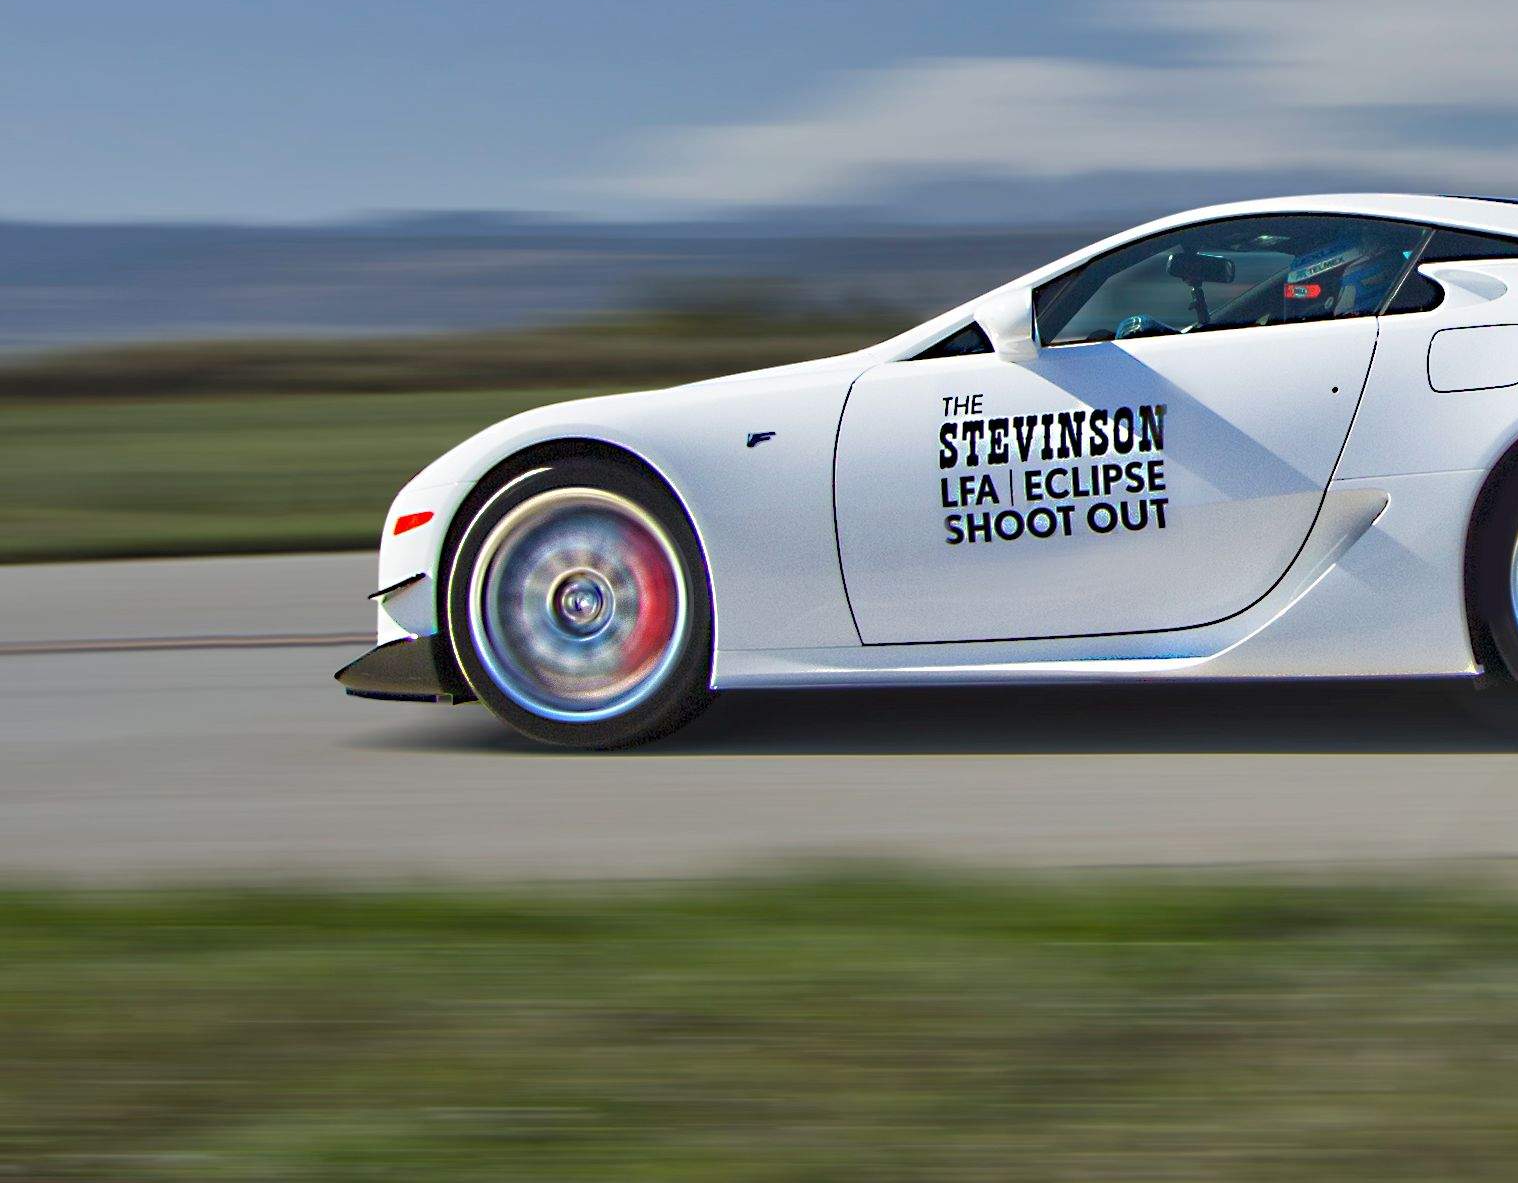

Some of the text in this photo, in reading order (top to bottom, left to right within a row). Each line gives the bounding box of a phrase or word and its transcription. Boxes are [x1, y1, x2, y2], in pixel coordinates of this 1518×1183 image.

[943, 394, 984, 416] THE
[939, 404, 1167, 469] STEVINSON
[941, 460, 1166, 507] LFA ECLIPSE
[945, 498, 1169, 544] SHOOT OUT
